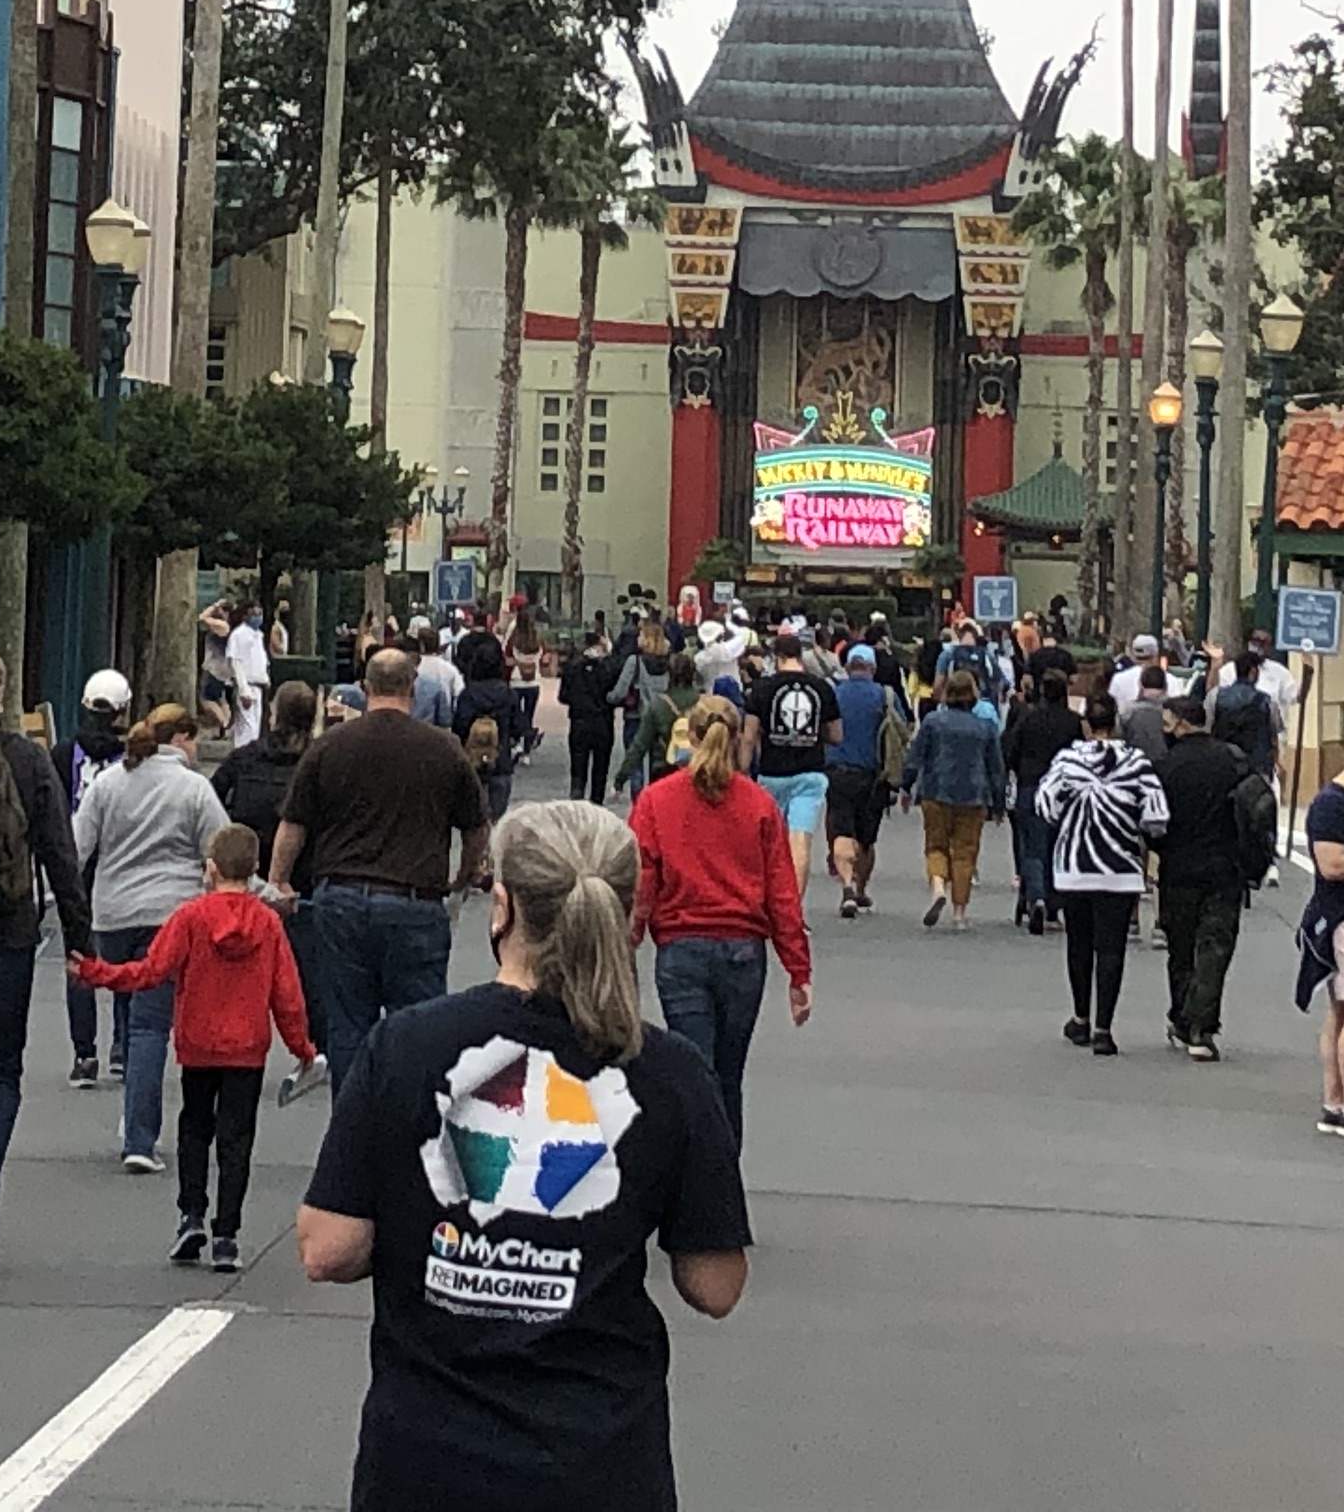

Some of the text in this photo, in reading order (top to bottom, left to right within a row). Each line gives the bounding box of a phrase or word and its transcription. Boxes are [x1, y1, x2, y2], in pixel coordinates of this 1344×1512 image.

[784, 493, 906, 522] RUNAWAY
[784, 516, 902, 550] RAILWAY
[460, 1231, 582, 1272] MyChart
[431, 1264, 568, 1301] REIMAGINED
